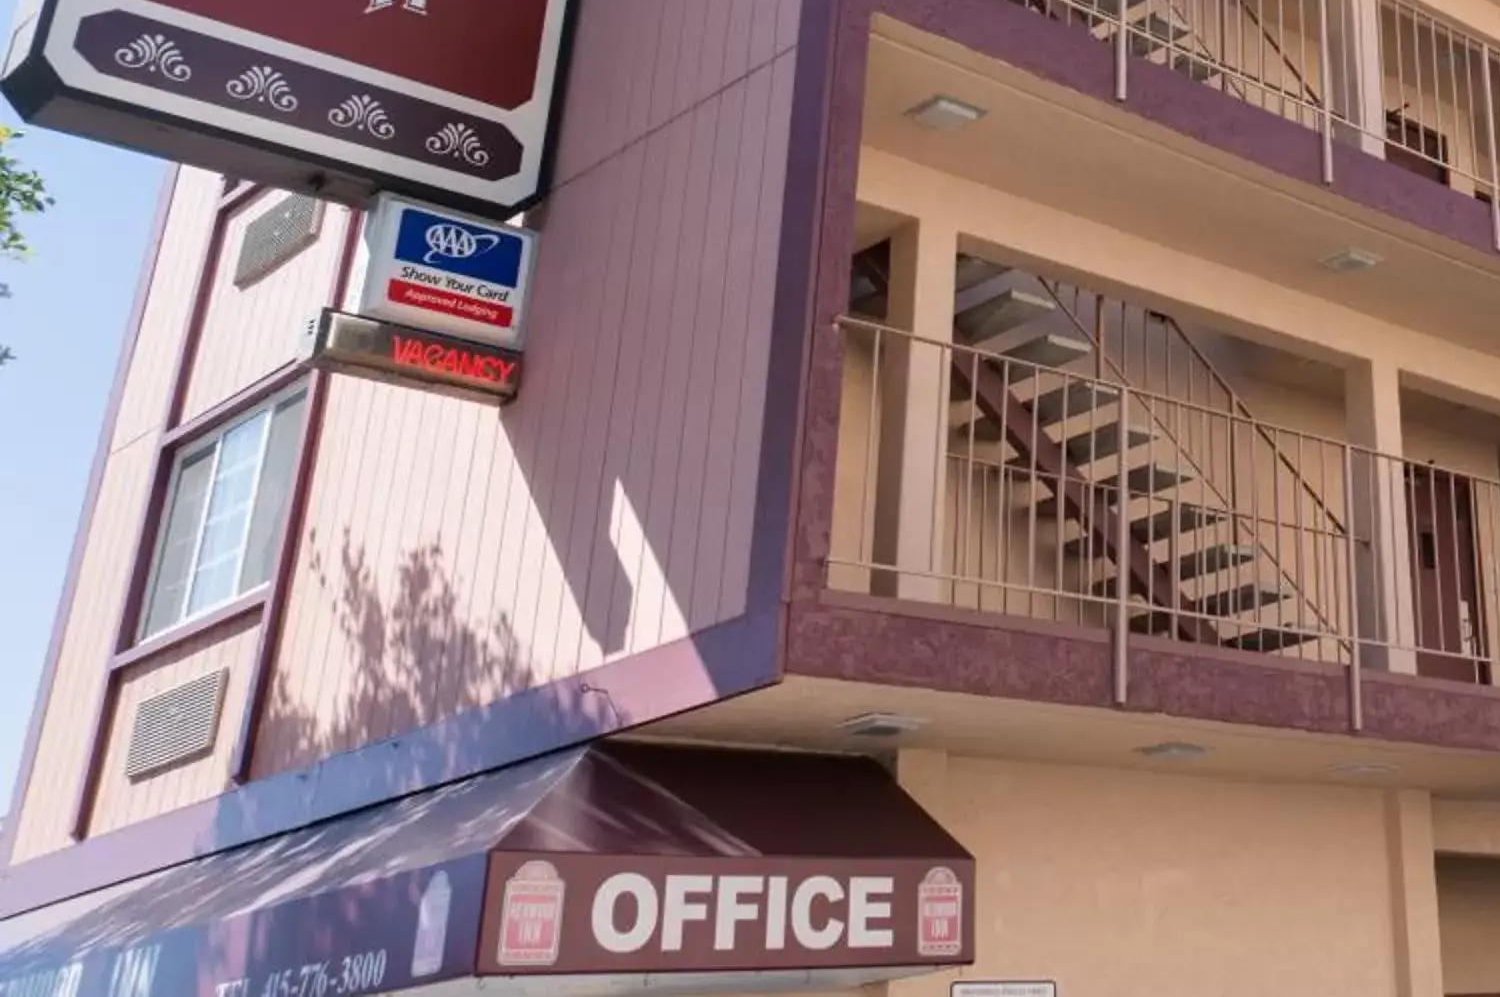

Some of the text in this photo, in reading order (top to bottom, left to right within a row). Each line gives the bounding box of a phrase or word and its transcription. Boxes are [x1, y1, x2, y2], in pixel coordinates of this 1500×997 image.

[428, 225, 470, 257] AAA
[401, 266, 511, 302] Show Your Card
[392, 334, 516, 384] VACANCY
[591, 872, 894, 954] OFFICE
